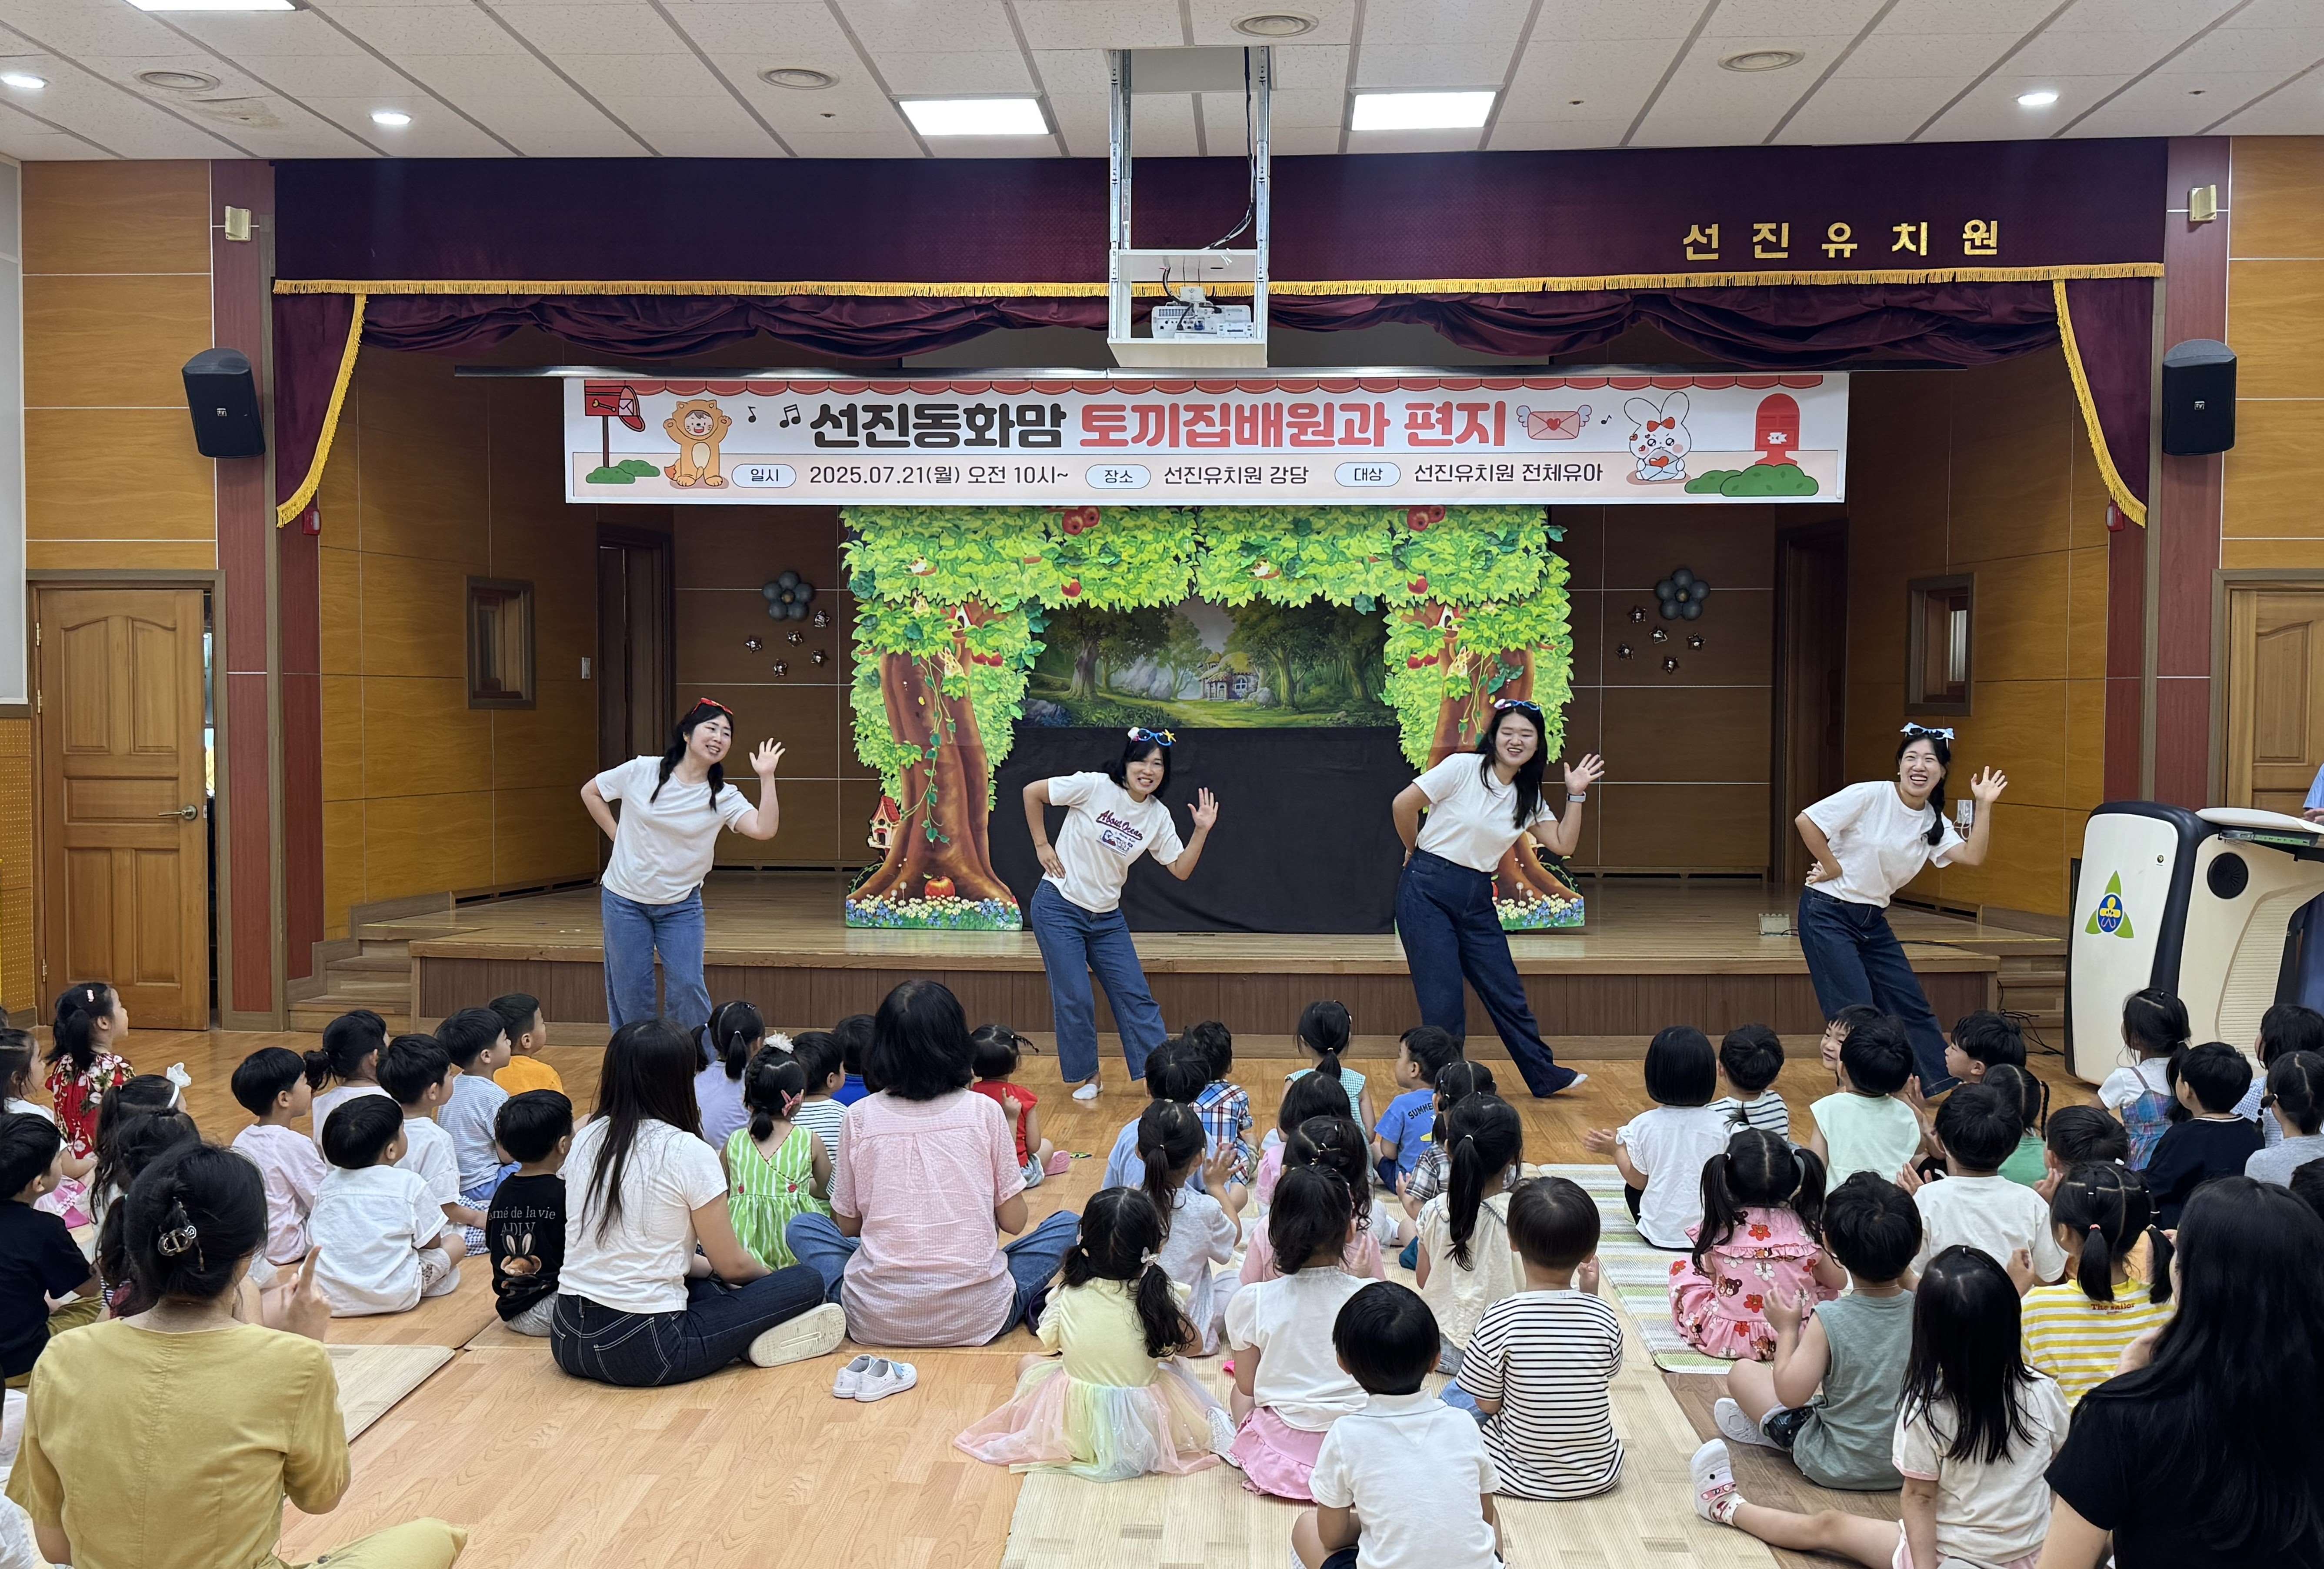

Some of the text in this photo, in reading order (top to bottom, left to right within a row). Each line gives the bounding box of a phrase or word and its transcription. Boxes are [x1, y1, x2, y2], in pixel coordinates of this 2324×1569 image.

[1684, 220, 1997, 260] 선진유치원
[810, 401, 1506, 448] 선진동화맘 토끼집배원과 편지
[750, 468, 779, 482] 일시
[810, 466, 1068, 484] 2025.07.21(월) 오전 10시~
[1105, 468, 1133, 483] 장소
[1164, 466, 1309, 485] 선진유치원 강당
[1354, 468, 1383, 481] 대상
[1414, 463, 1603, 483] 선진유치원 전체유아
[1097, 810, 1122, 828] About
[1122, 822, 1143, 838] Ocean
[1408, 1103, 1434, 1119] SUMME
[511, 1206, 522, 1218] de
[526, 1206, 536, 1218] la
[539, 1206, 556, 1219] vie
